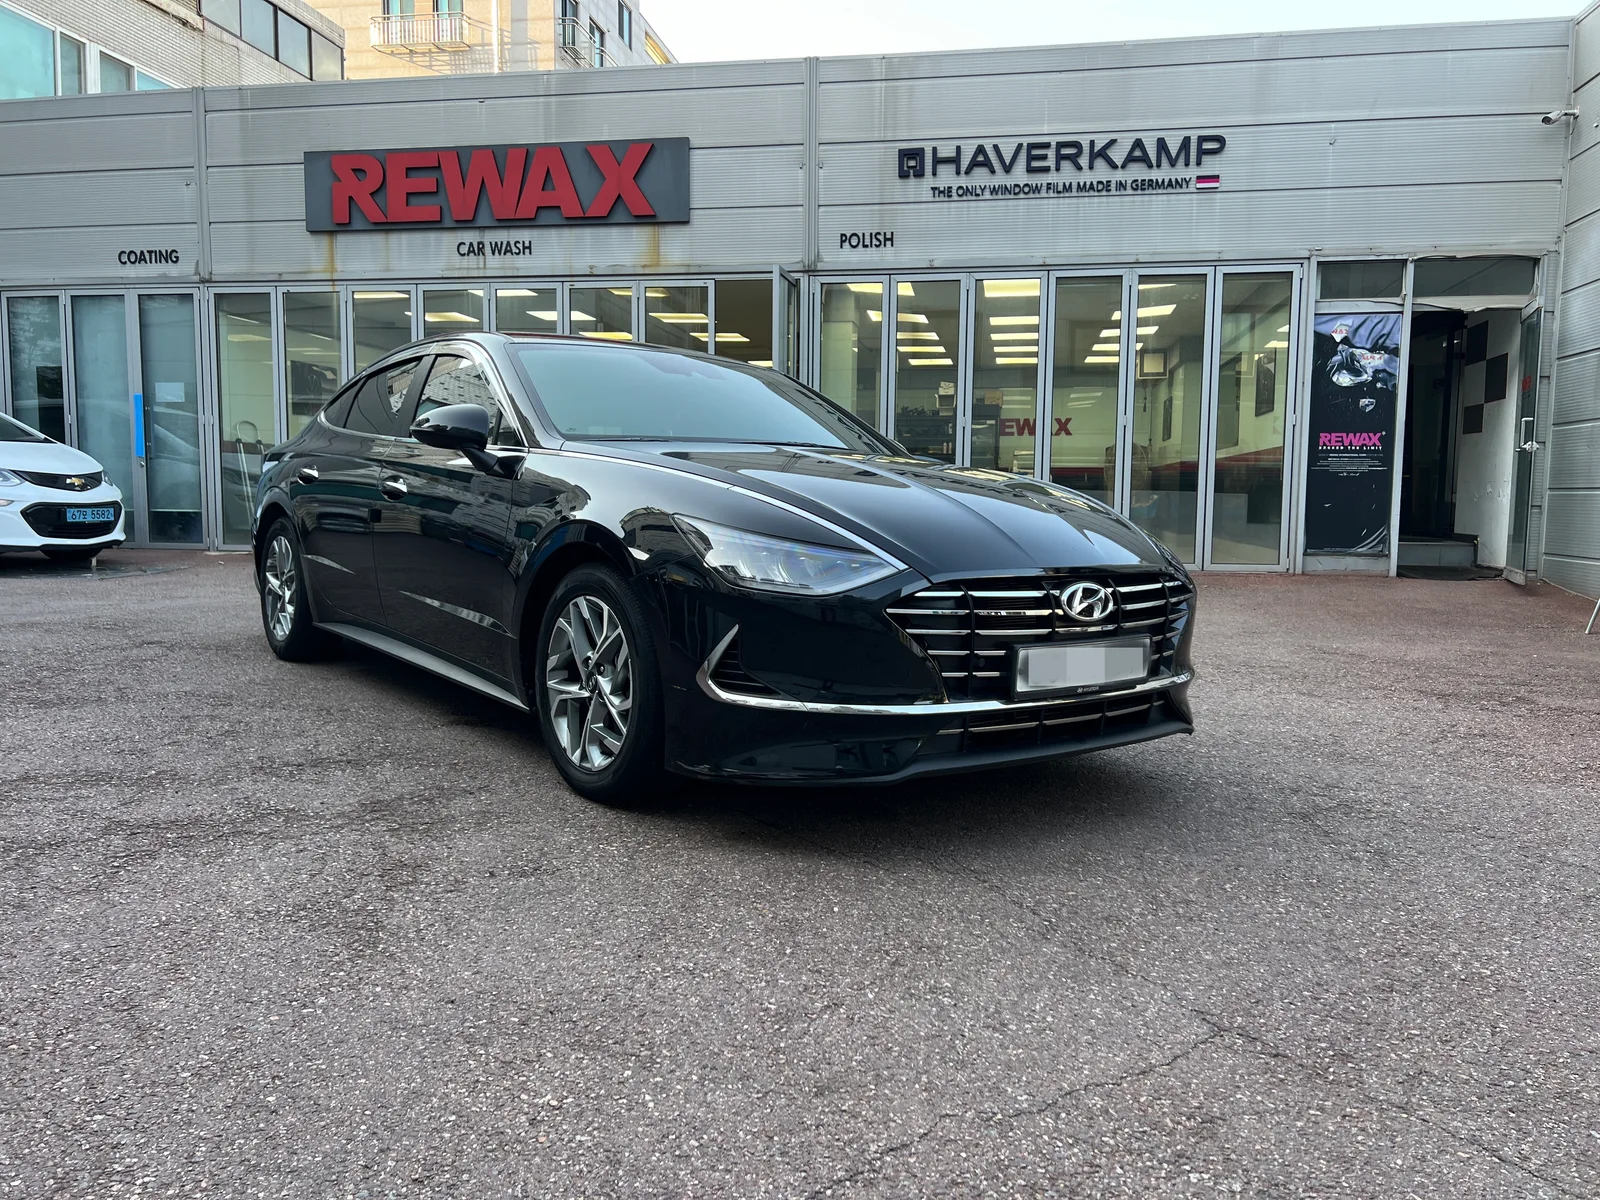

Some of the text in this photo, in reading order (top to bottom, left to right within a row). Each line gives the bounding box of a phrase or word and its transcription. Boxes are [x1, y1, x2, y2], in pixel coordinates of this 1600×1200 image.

[932, 134, 1227, 176] HAVERKAMP
[331, 142, 656, 225] REWAX
[931, 177, 1192, 198] THE ONLY WINDOW FILM MADE IN GERMANY
[456, 240, 532, 257] CAR WASH
[840, 231, 894, 249] POLISH
[117, 249, 180, 265] COATING
[1319, 432, 1381, 446] REWAX
[90, 509, 111, 520] 5582
